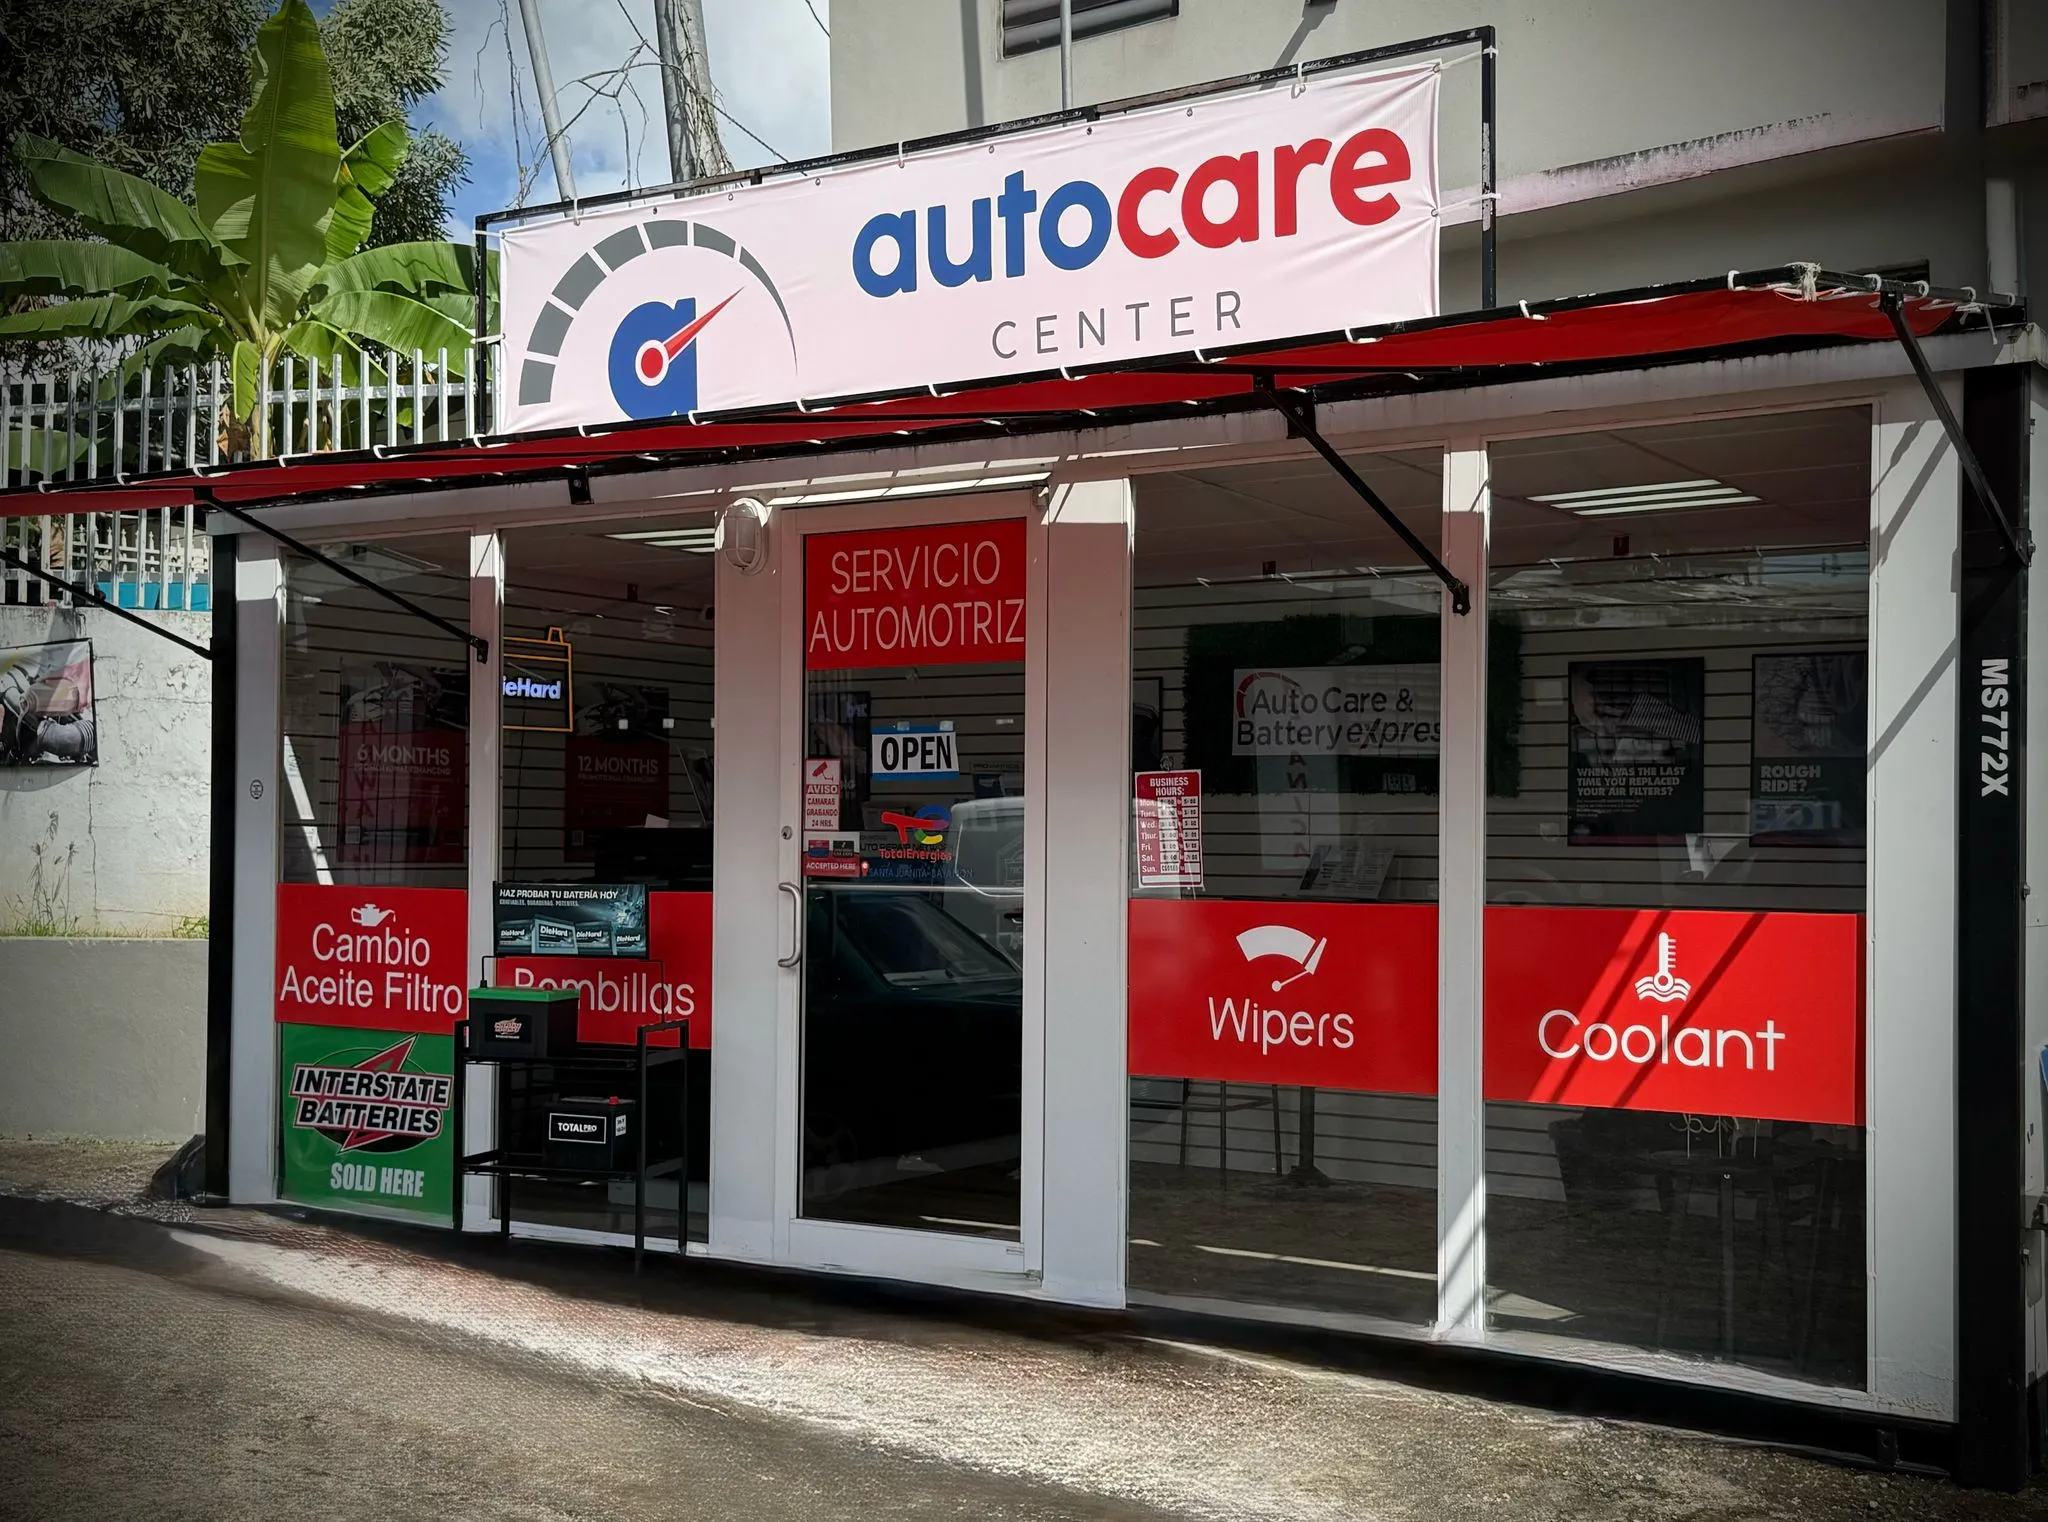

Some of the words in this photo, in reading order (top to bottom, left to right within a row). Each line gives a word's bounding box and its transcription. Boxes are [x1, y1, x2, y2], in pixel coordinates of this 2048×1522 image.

[852, 128, 1411, 298] autocare
[992, 291, 1243, 359] CENTER
[832, 541, 1000, 594] SERVICIO
[809, 599, 1025, 653] AUTOMOTRIZ
[502, 675, 561, 700] ieHard
[1251, 688, 1318, 714] Auto
[1322, 687, 1388, 713] Care
[1396, 688, 1414, 712] &
[1237, 719, 1342, 750] Battery
[1346, 718, 1440, 749] expres
[1981, 659, 2009, 798] MS772X
[372, 745, 450, 766] MONTHS
[578, 756, 592, 772] 12
[595, 756, 658, 775] MONTHS
[880, 736, 952, 770] OPEN
[1150, 777, 1189, 787] BUSINESS
[1577, 767, 1608, 777] WHEN
[1613, 767, 1635, 777] WAS
[1638, 767, 1657, 776] THE
[1659, 767, 1686, 776] LAST
[1577, 778, 1601, 787] TIME
[1605, 777, 1626, 786] YOU
[1629, 777, 1680, 786] REPLACED
[1760, 765, 1821, 778] ROUGH
[1760, 779, 1807, 792] RIDE?
[807, 785, 838, 794] AVISO
[1155, 787, 1185, 796] HOURS:
[1577, 787, 1605, 797] YOUR
[1608, 787, 1627, 797] AIR
[1629, 786, 1674, 796] FILTERS?
[500, 889, 515, 897] HAZ
[517, 890, 549, 898] PROBAR
[564, 889, 598, 899] BATERÍA
[600, 891, 618, 899] HOY
[312, 924, 430, 967] Cambio
[540, 925, 568, 937] DieHard
[280, 965, 374, 1010] Aceite
[384, 971, 462, 1014] Filtro
[1208, 997, 1354, 1055] Wipers
[1538, 1009, 1786, 1071] Coolant
[293, 1068, 452, 1104] INTERSTATE
[299, 1101, 441, 1134] BATTERIES
[330, 1161, 376, 1192] SOLD
[380, 1166, 425, 1197] HERE
